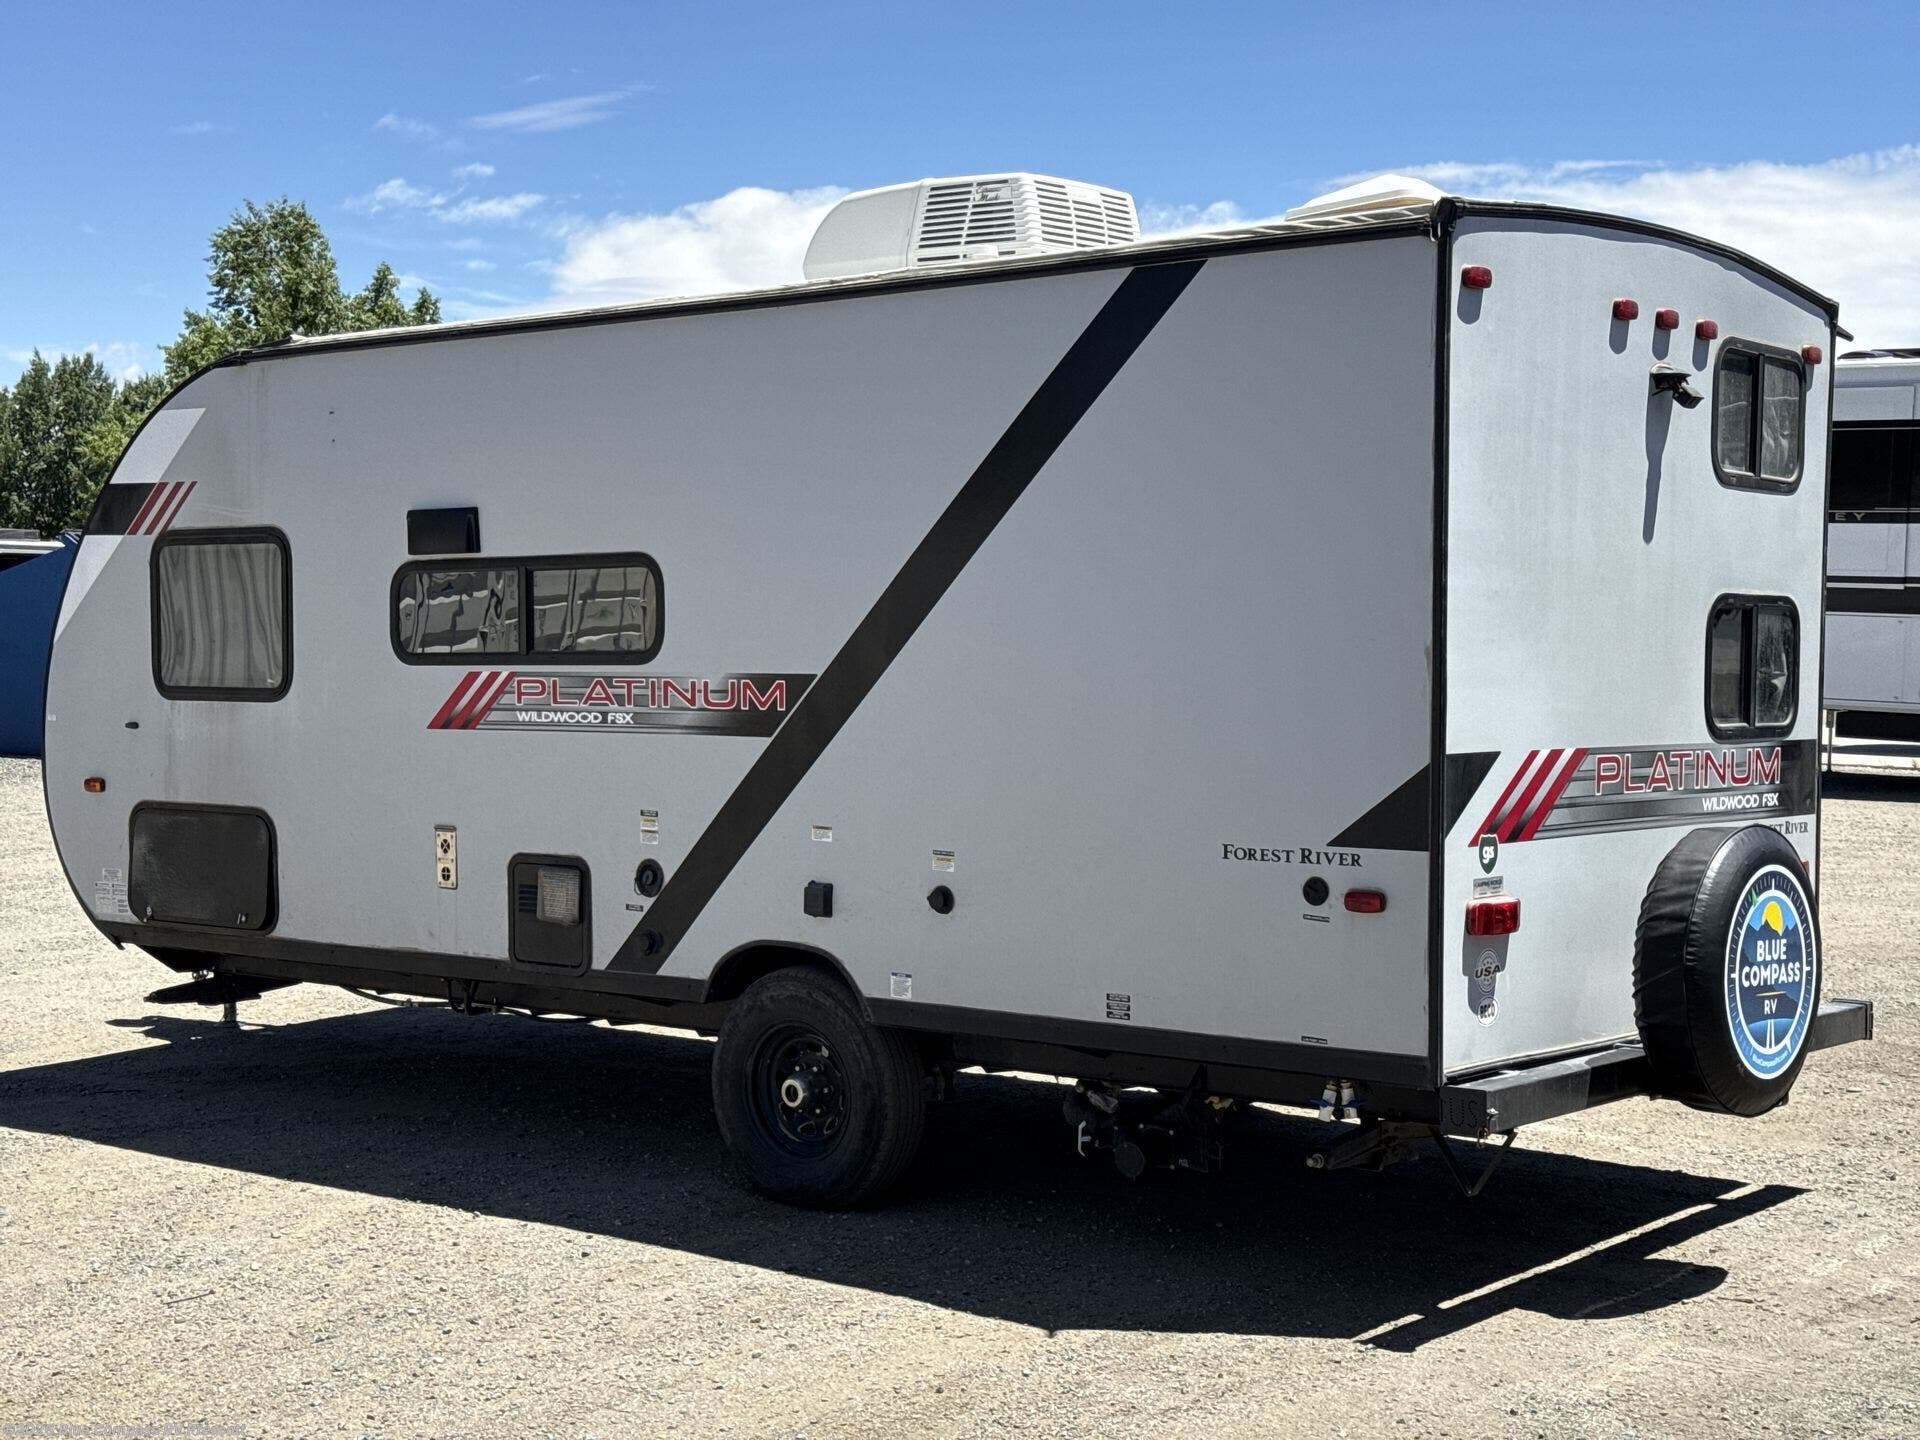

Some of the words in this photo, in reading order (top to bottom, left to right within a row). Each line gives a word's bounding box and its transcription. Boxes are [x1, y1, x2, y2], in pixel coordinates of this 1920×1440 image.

[515, 677, 786, 710] PLATINUM
[516, 710, 602, 724] WILDWOOD
[607, 712, 635, 725] FSX
[1595, 747, 1781, 795] PLATINUM
[1702, 794, 1760, 812] WILDWOOD
[1761, 792, 1780, 807] FSX
[1784, 820, 1809, 835] RIVER
[1222, 844, 1294, 863] FOREST
[1299, 847, 1362, 867] RIVER
[1482, 845, 1495, 864] gs
[1756, 938, 1787, 962] BLUE
[1475, 965, 1501, 979] USA
[1741, 961, 1801, 988] COMPASS
[1764, 998, 1778, 1016] RV
